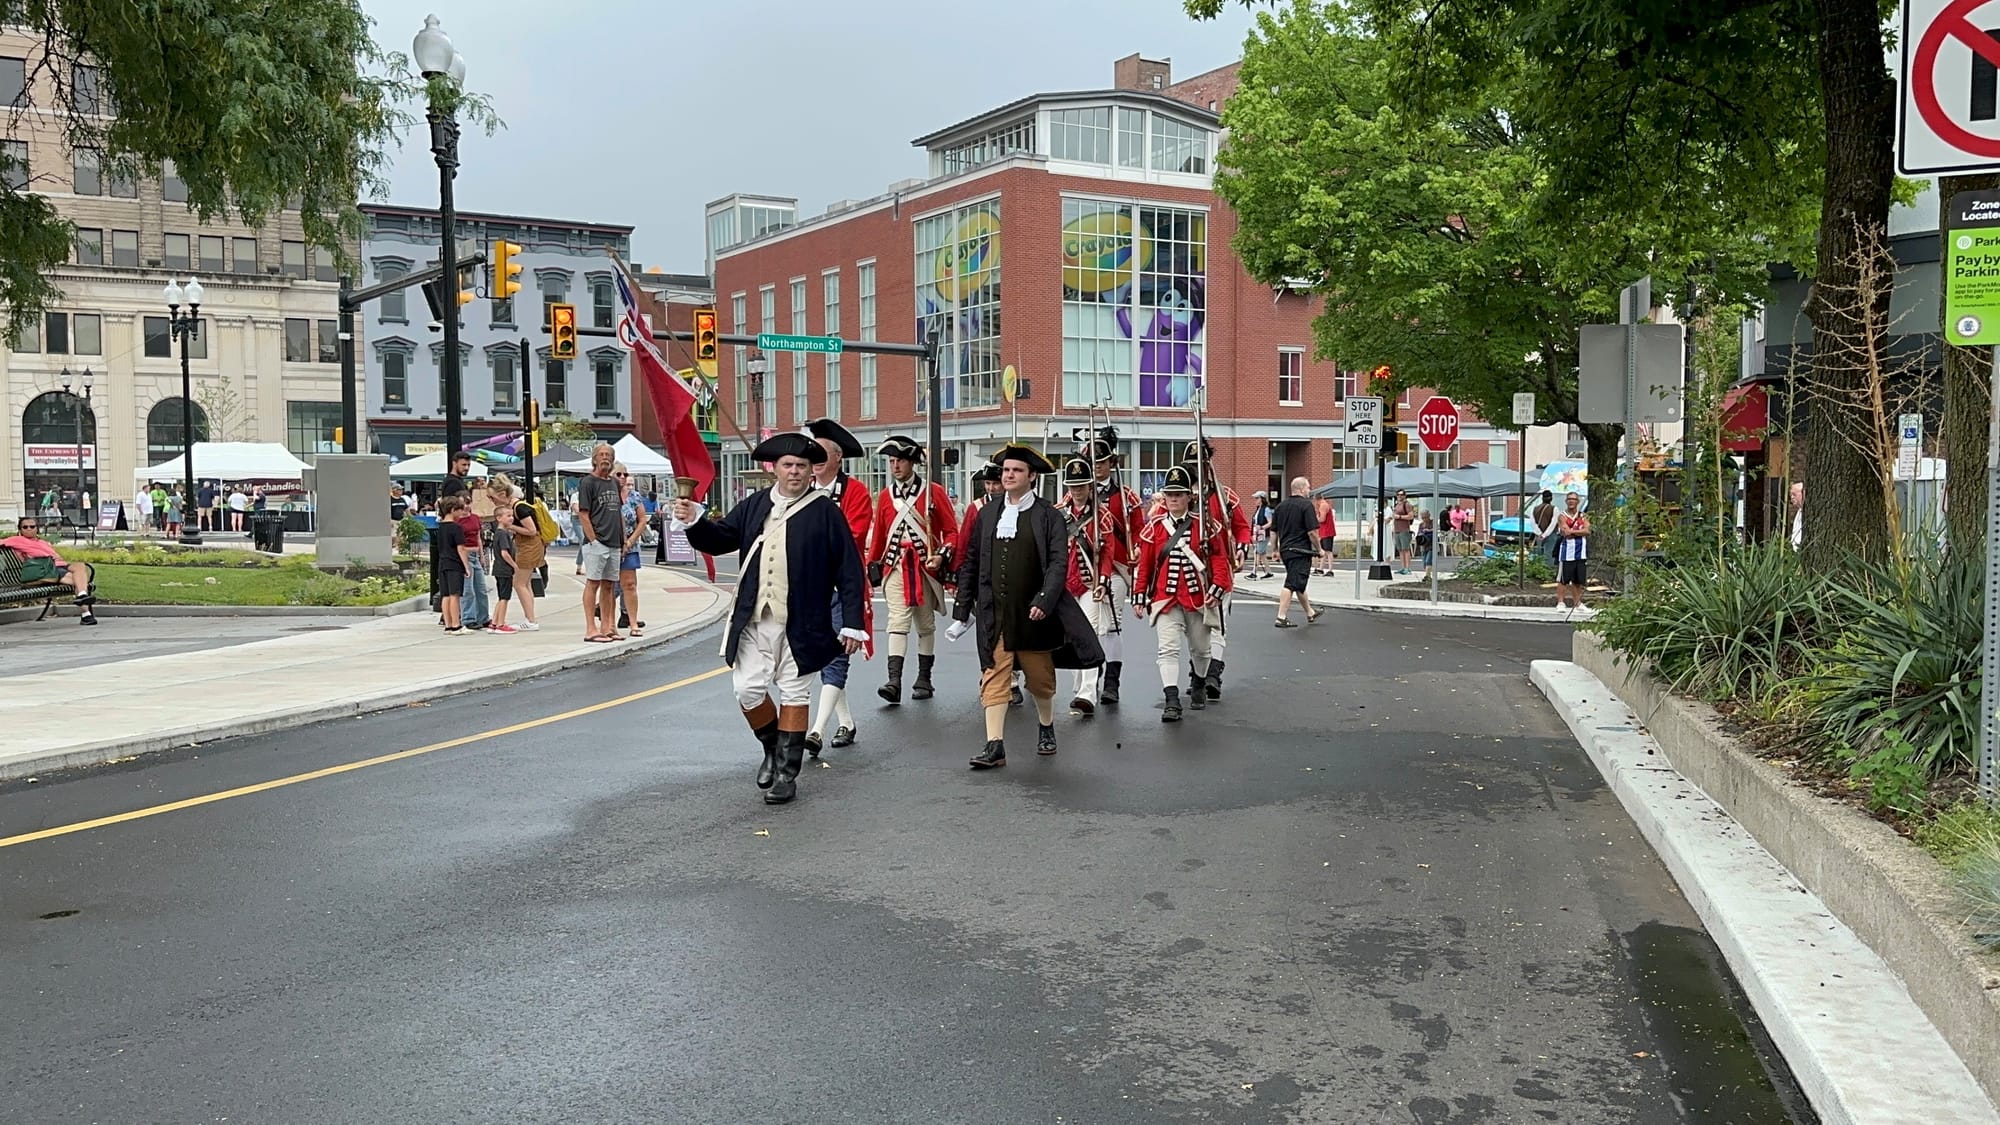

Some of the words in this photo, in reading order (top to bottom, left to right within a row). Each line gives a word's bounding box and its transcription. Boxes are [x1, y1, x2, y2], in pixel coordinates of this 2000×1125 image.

[1971, 200, 2000, 210] Zone
[1961, 210, 2000, 221] Locate
[944, 227, 989, 268] Cayola
[1064, 229, 1133, 257] Crayola
[1955, 255, 1982, 267] Pay
[1983, 253, 2000, 266] by
[761, 336, 825, 351] Northampton
[828, 340, 839, 351] St
[1351, 401, 1377, 411] STOP
[1420, 414, 1457, 435] STOP
[1357, 434, 1378, 444] RED
[243, 481, 301, 492] Mchandise
